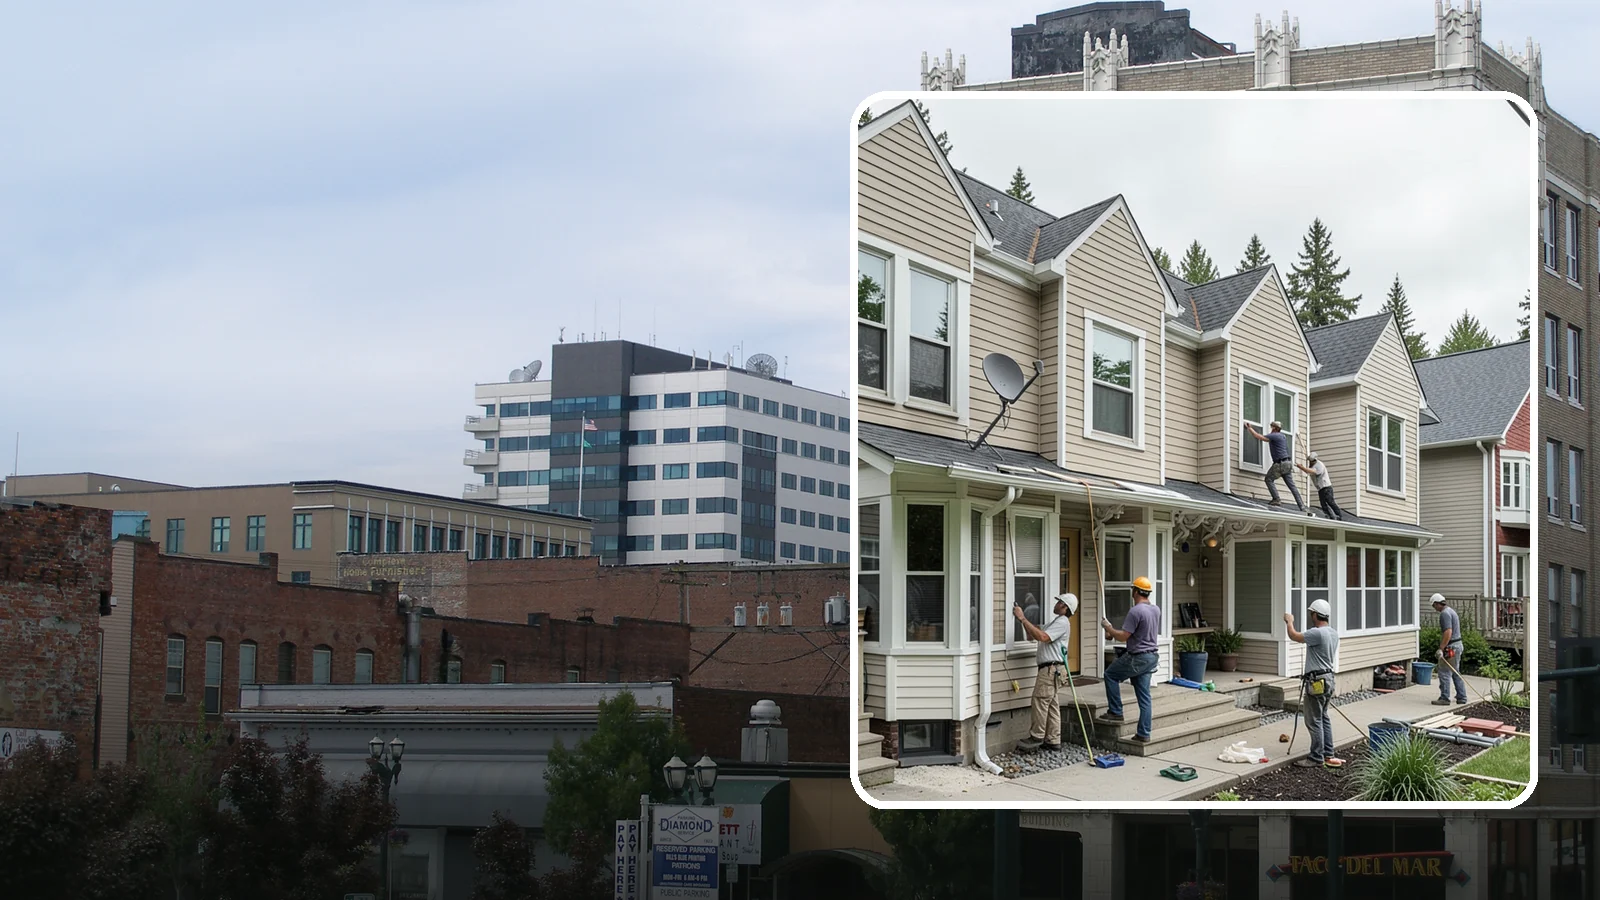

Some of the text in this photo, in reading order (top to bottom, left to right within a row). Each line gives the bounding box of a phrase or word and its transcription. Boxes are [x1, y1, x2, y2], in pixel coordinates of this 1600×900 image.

[370, 566, 427, 576] Furnishers
[660, 818, 713, 833] DIAMOND
[1021, 814, 1070, 828] BUILDING
[656, 845, 688, 853] RESERVED
[616, 825, 625, 894] PAY HERE
[627, 824, 637, 894] PAY HERE
[722, 851, 739, 863] Soup
[671, 862, 701, 870] PATRONS
[1346, 857, 1385, 876] DEL
[1392, 857, 1443, 877] MAR
[661, 888, 710, 898] PUBLIC PARKING
